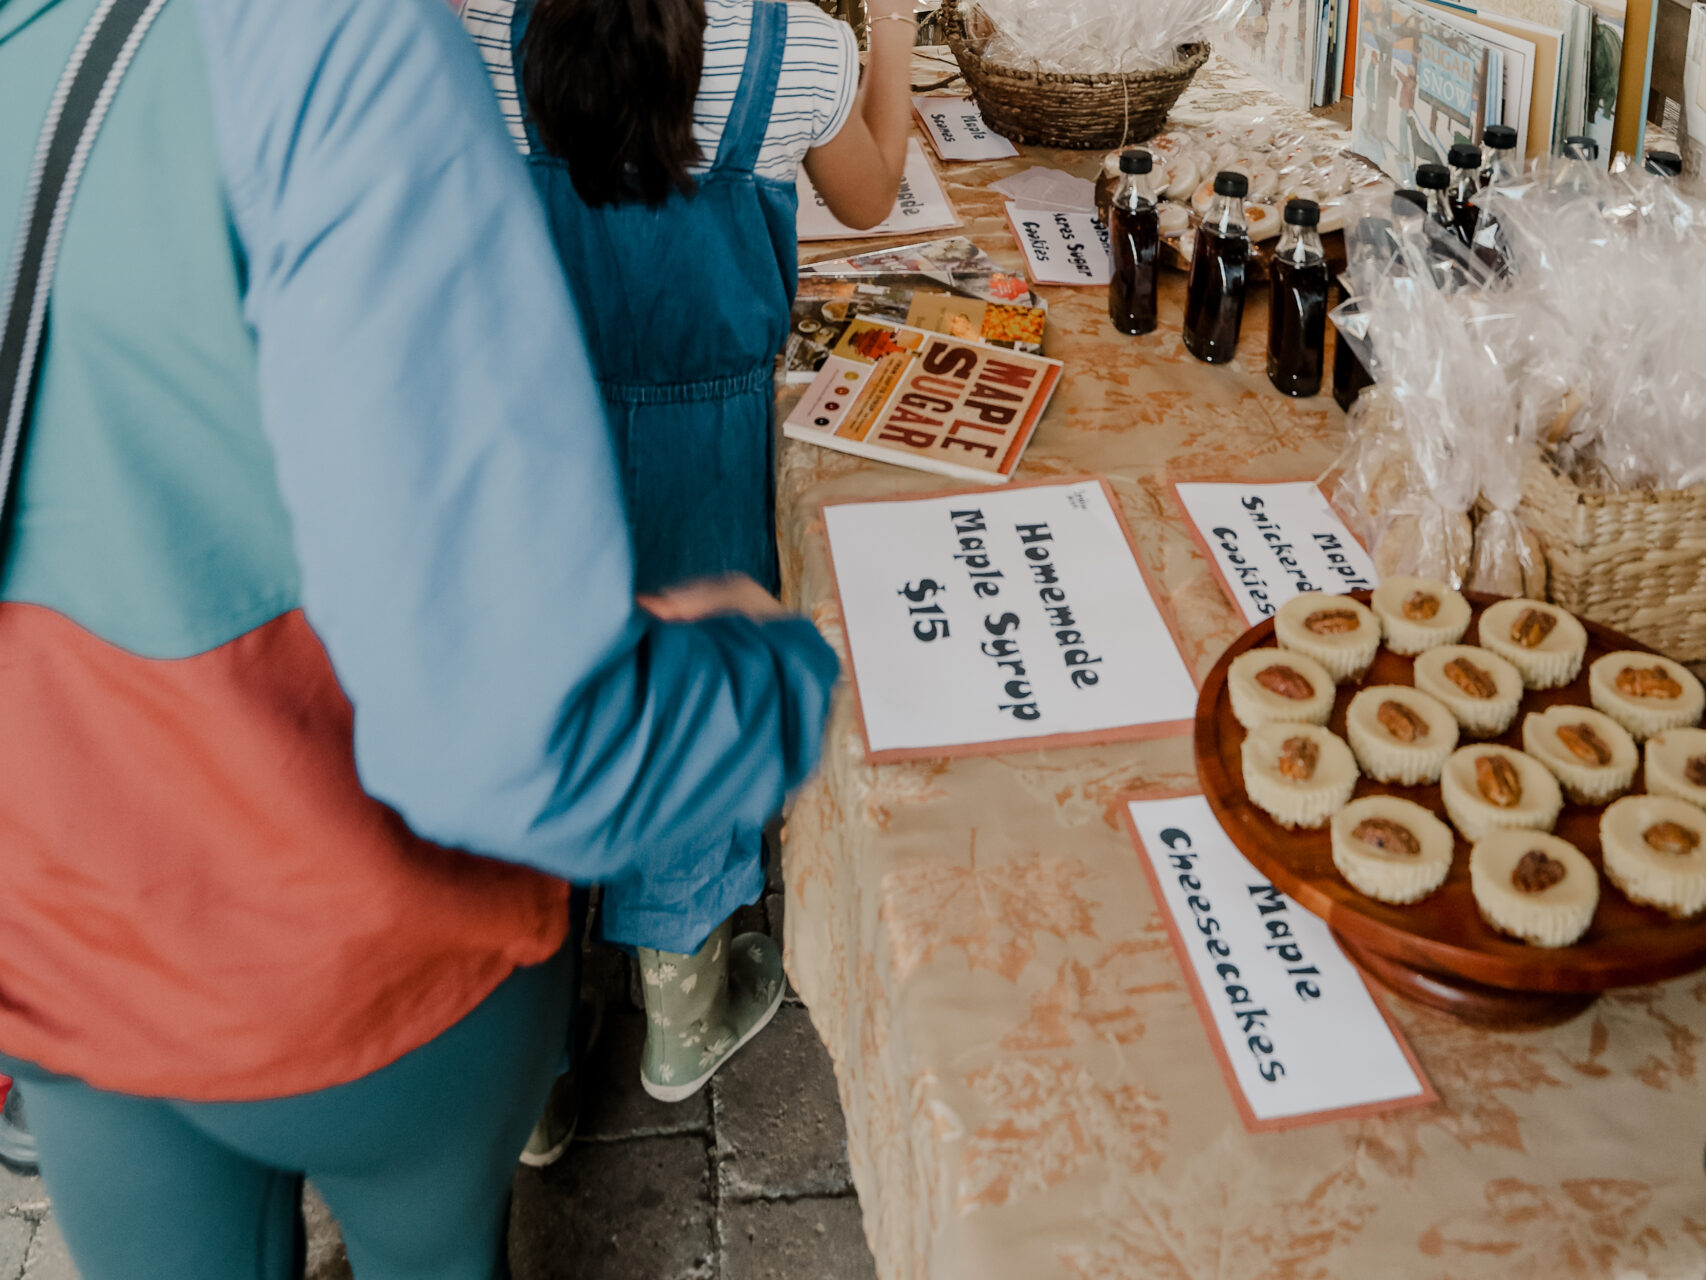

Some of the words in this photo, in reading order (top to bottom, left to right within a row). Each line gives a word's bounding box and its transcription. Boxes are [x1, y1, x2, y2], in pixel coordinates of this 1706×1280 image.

[1422, 39, 1471, 84] SUGAR
[1422, 67, 1471, 110] SNOW
[930, 113, 956, 143] Scones
[960, 115, 987, 141] Maple
[1022, 221, 1050, 262] Cookies
[1066, 243, 1093, 278] Sugar
[878, 341, 979, 449] SUGAR
[940, 359, 1038, 459] MAPLE
[1212, 526, 1277, 617] Cookies
[1241, 495, 1323, 593] Snickerd
[897, 577, 951, 643] $15
[950, 507, 1005, 599] Maple
[981, 611, 1041, 722] Syrup
[1015, 521, 1102, 690] Homemade
[1159, 827, 1285, 1083] Cheesecakes
[1246, 882, 1321, 1002] Maple
